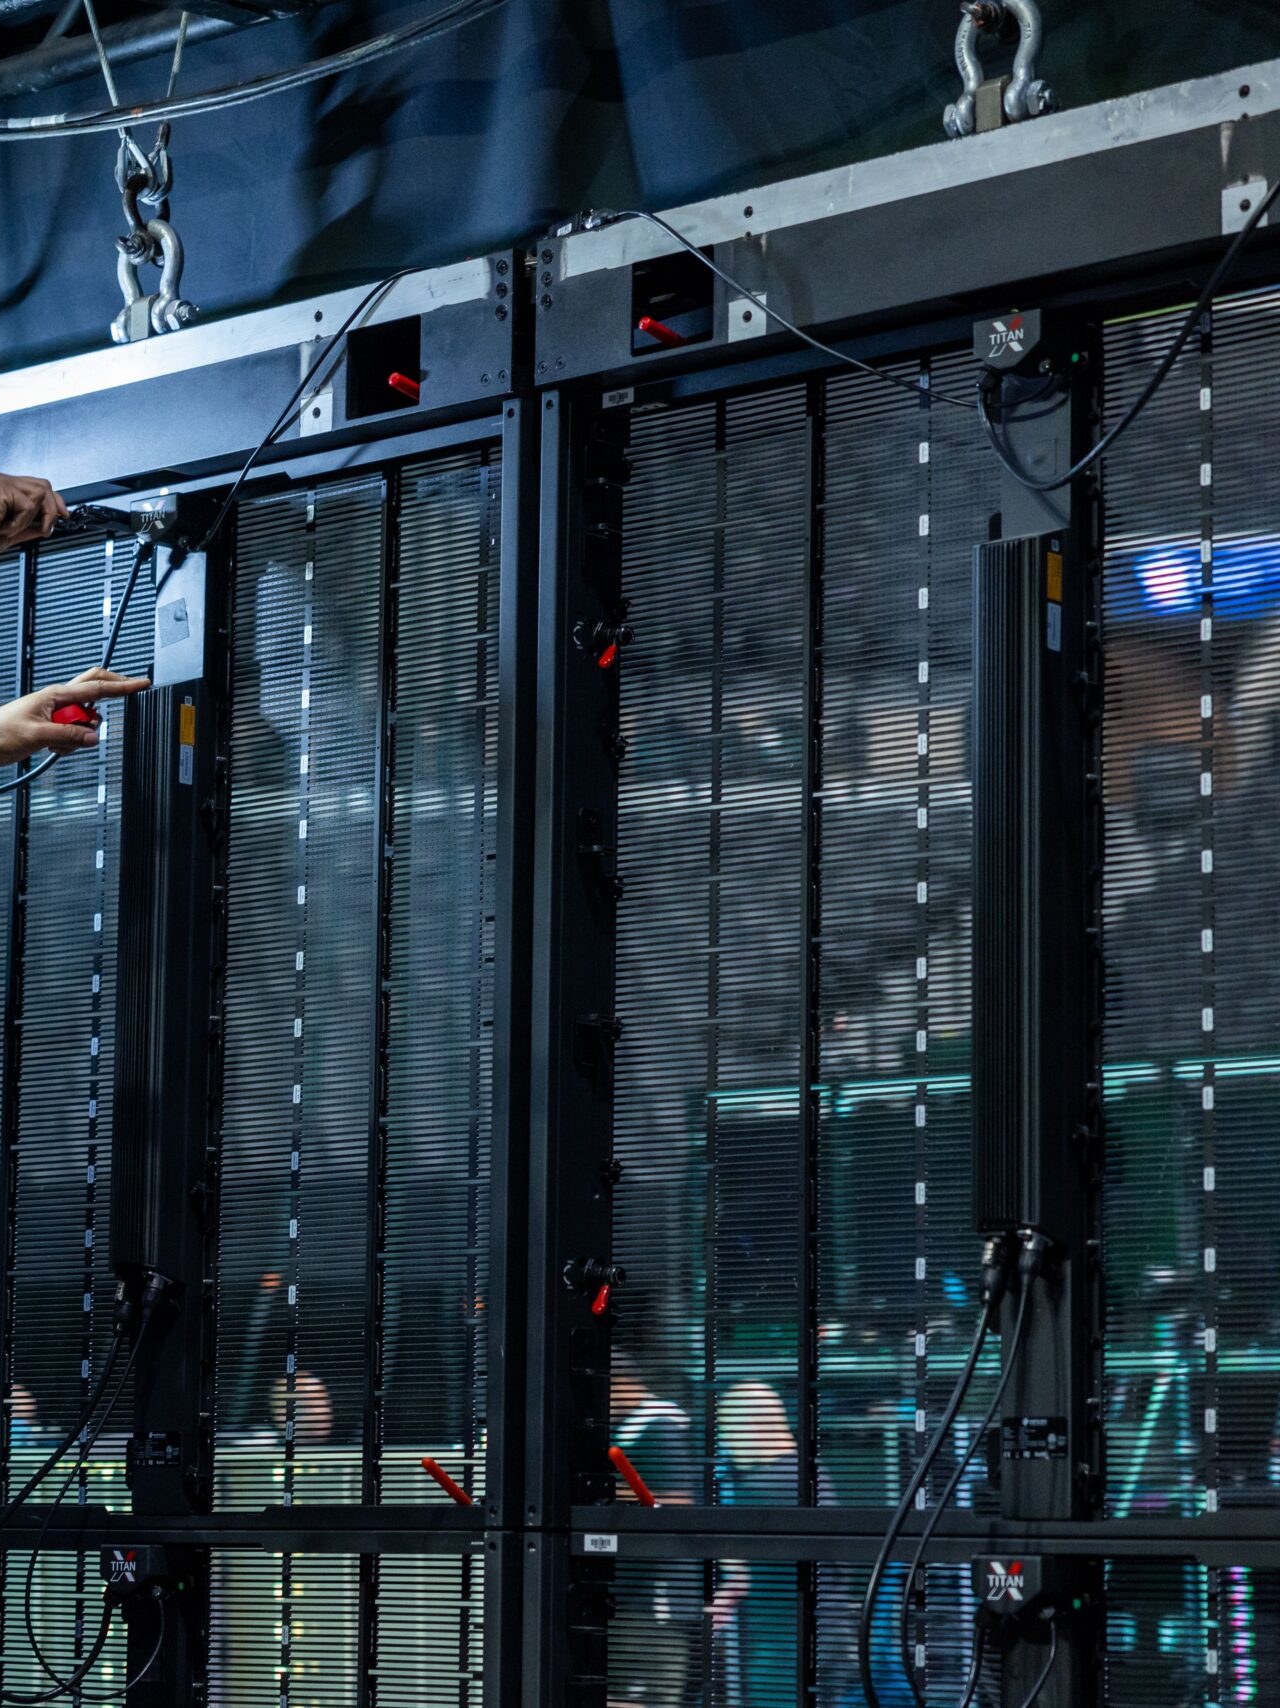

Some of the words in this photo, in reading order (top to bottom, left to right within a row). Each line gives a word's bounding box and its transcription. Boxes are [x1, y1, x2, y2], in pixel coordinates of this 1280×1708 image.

[989, 328, 1024, 345] TITAN
[140, 508, 165, 523] TITAN
[110, 1561, 136, 1572] TITAN
[986, 1574, 1024, 1588] TITAN
